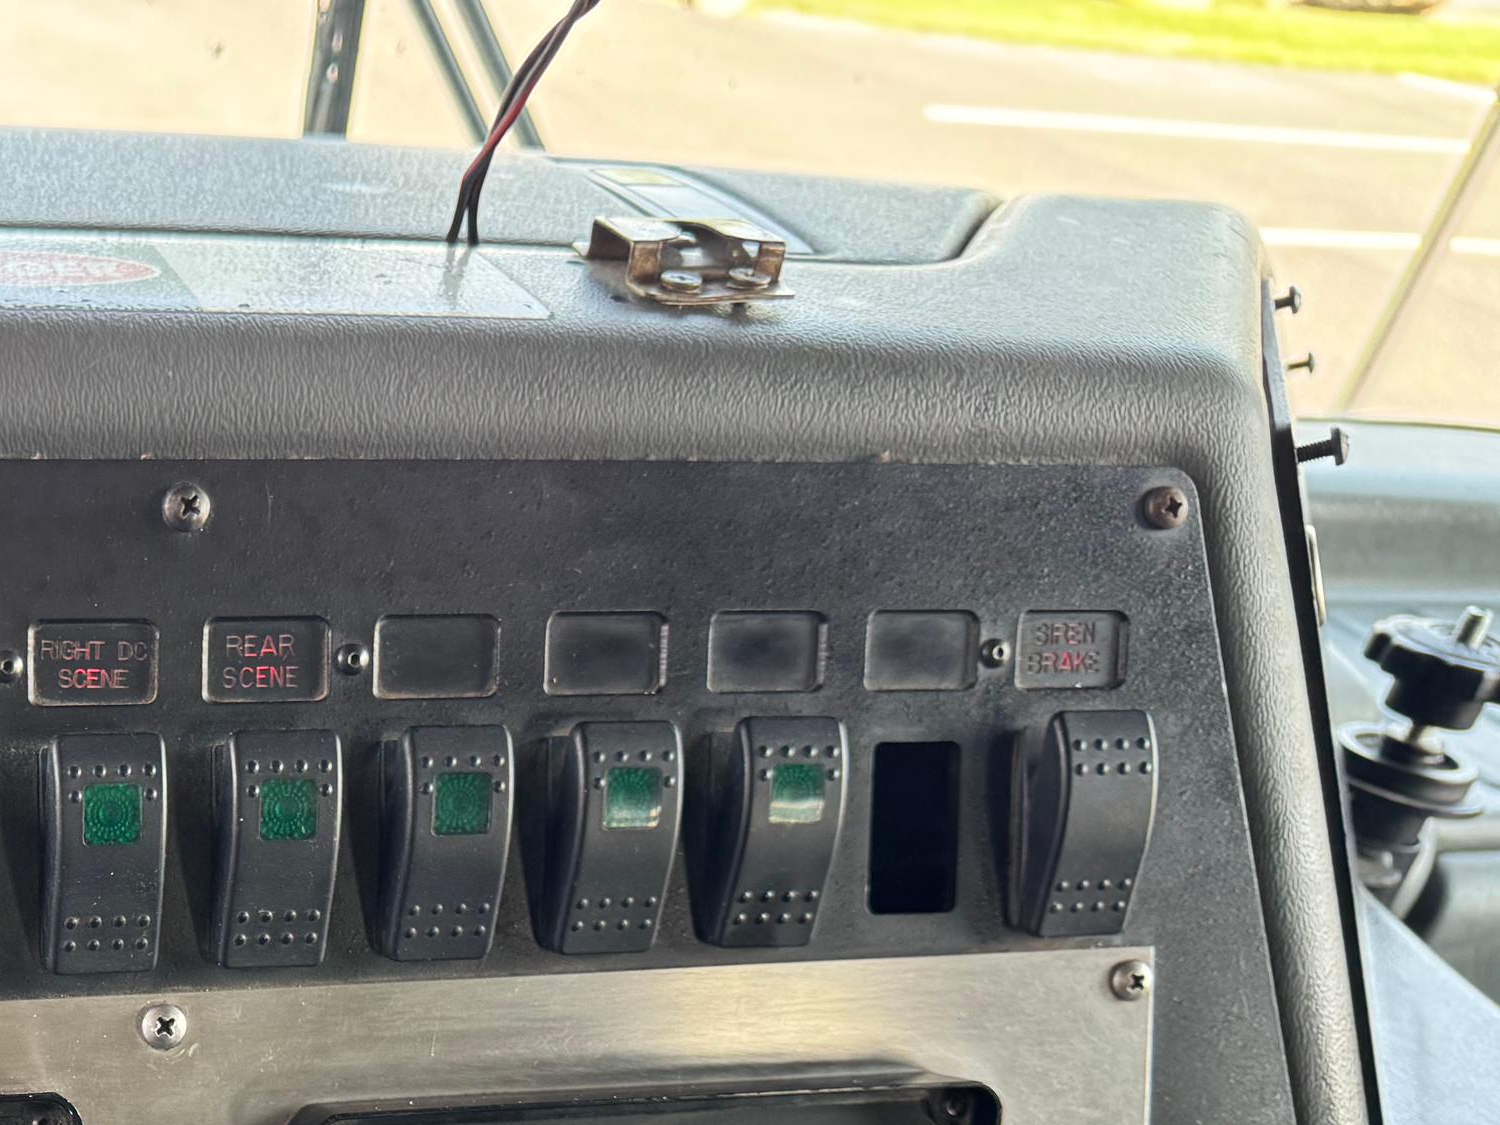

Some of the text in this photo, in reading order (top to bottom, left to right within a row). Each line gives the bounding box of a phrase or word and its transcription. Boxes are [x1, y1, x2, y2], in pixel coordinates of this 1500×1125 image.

[225, 633, 296, 658] REAR
[1035, 621, 1096, 646] SIREN
[40, 639, 148, 662] RIGHT DC
[1027, 650, 1101, 675] BRAKE
[58, 668, 130, 690] SCENE
[222, 665, 300, 689] SCENE
